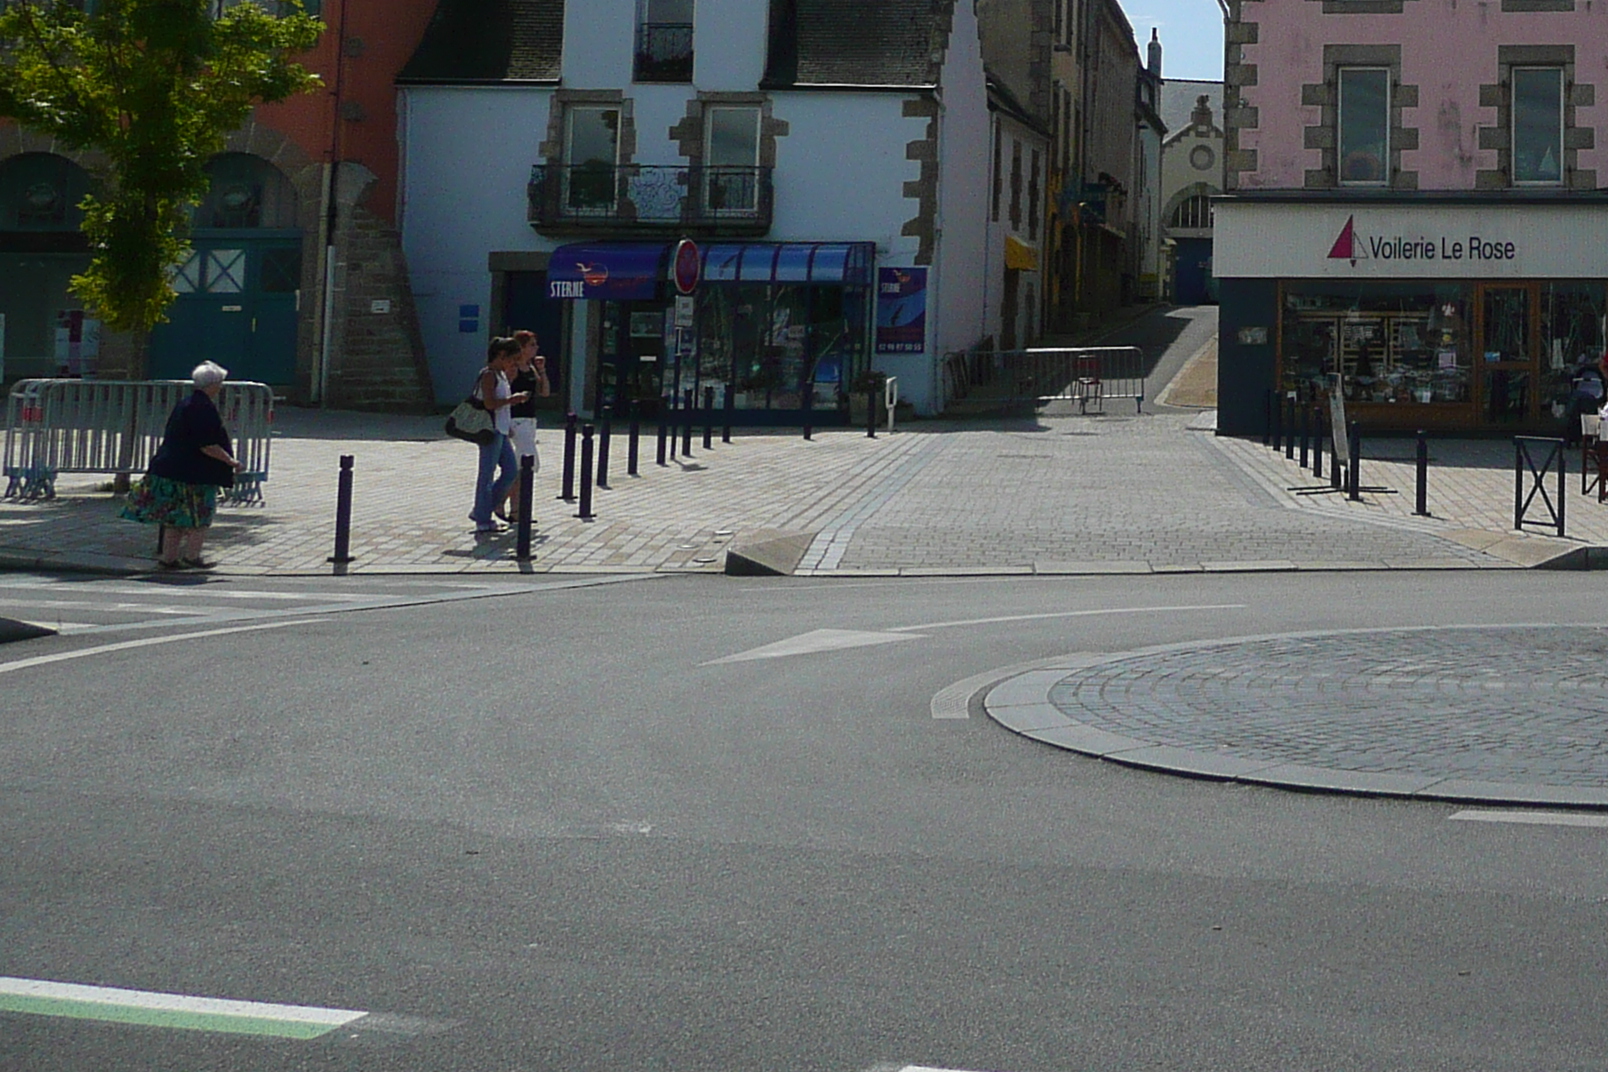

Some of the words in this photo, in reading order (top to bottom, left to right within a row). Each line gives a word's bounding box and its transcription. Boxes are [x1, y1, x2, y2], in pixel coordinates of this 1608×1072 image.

[1370, 236, 1436, 260] Voilerie
[1441, 236, 1463, 260] Le
[1469, 236, 1515, 260] Rose
[550, 281, 584, 298] STERNE
